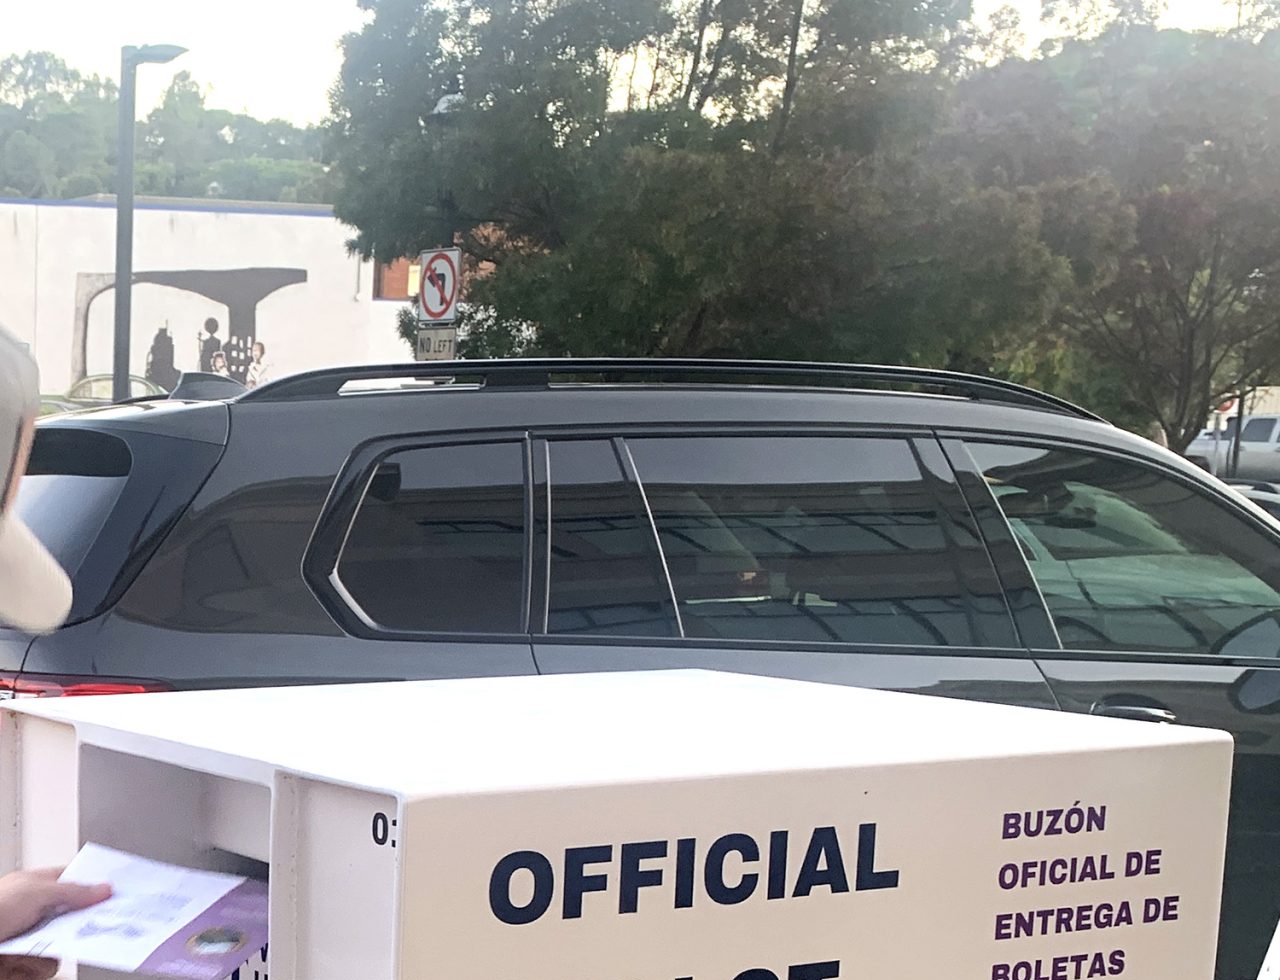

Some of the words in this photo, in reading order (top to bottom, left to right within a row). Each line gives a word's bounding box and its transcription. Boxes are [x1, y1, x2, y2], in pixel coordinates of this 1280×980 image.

[420, 337, 431, 353] NO
[433, 340, 452, 353] LEFT
[1002, 800, 1106, 839] BUZÓN
[489, 823, 899, 925] OFFICIAL
[998, 854, 1115, 890] OFICIAL
[1124, 849, 1162, 877] DE
[994, 900, 1133, 940] ENTREGA
[1142, 895, 1179, 923] DE
